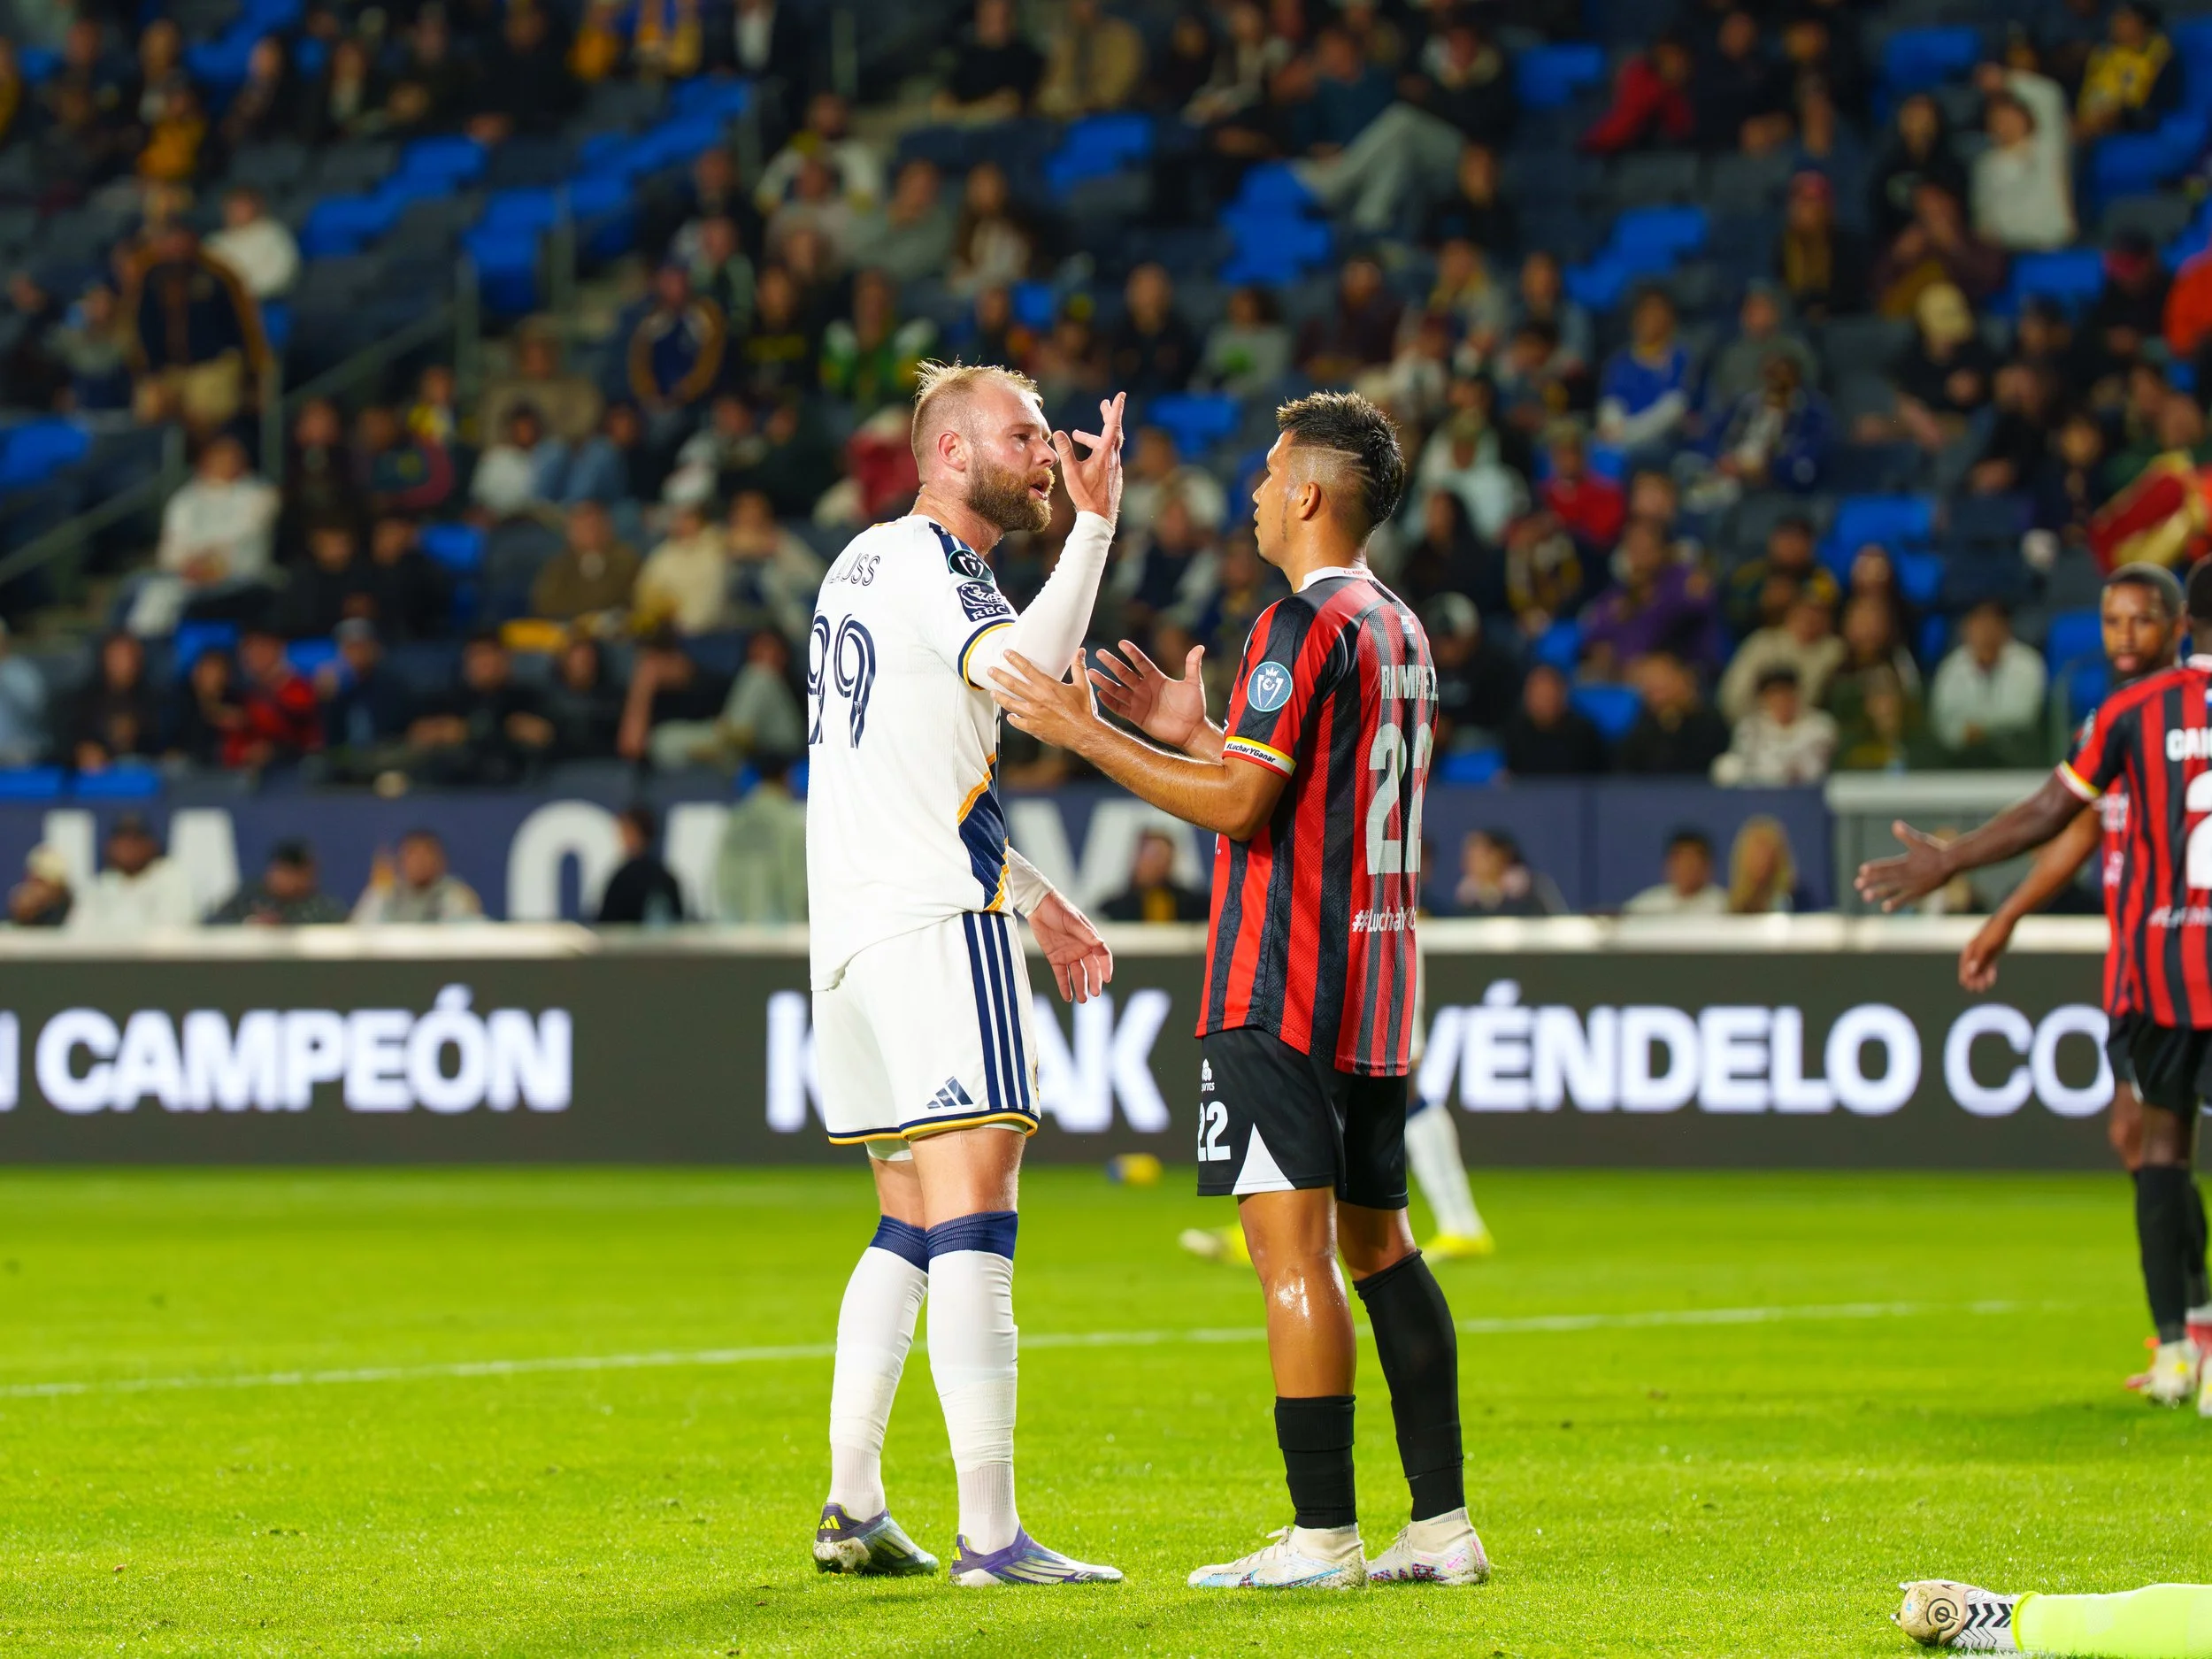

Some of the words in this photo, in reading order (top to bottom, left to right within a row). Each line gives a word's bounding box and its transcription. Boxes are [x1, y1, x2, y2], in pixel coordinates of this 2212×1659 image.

[971, 605, 1009, 620] RBC
[807, 610, 876, 749] 99
[1226, 742, 1276, 763] #LucharYGanar
[1366, 722, 1434, 875] 22
[35, 983, 572, 1114] CAMPEÓN
[1197, 1101, 1232, 1162] 22
